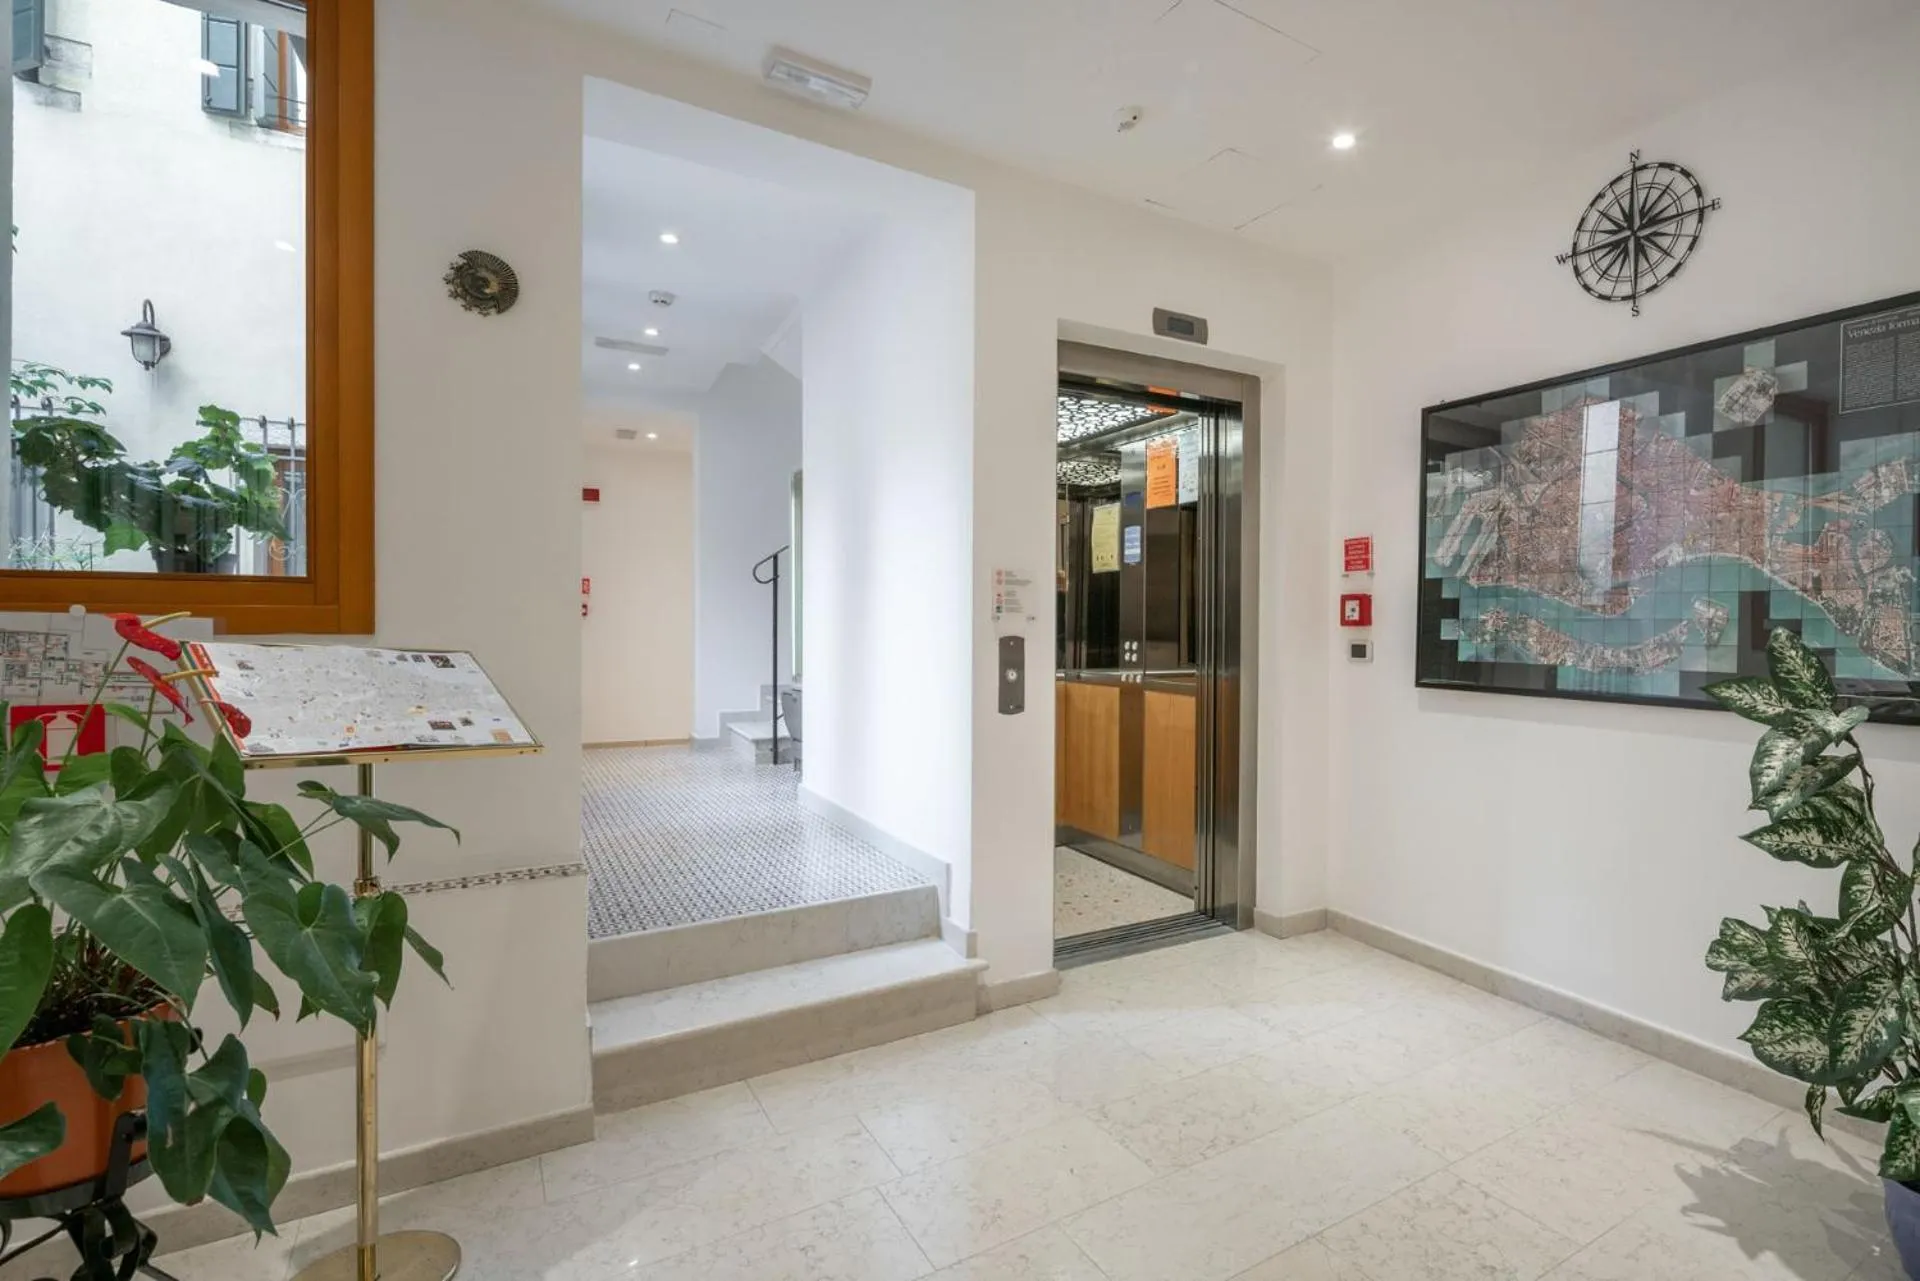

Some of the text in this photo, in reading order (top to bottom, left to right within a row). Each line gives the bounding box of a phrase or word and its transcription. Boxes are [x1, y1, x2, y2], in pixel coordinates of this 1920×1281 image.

[1629, 149, 1640, 163] N
[1711, 198, 1721, 211] E
[1555, 253, 1569, 265] W
[1631, 305, 1640, 317] S
